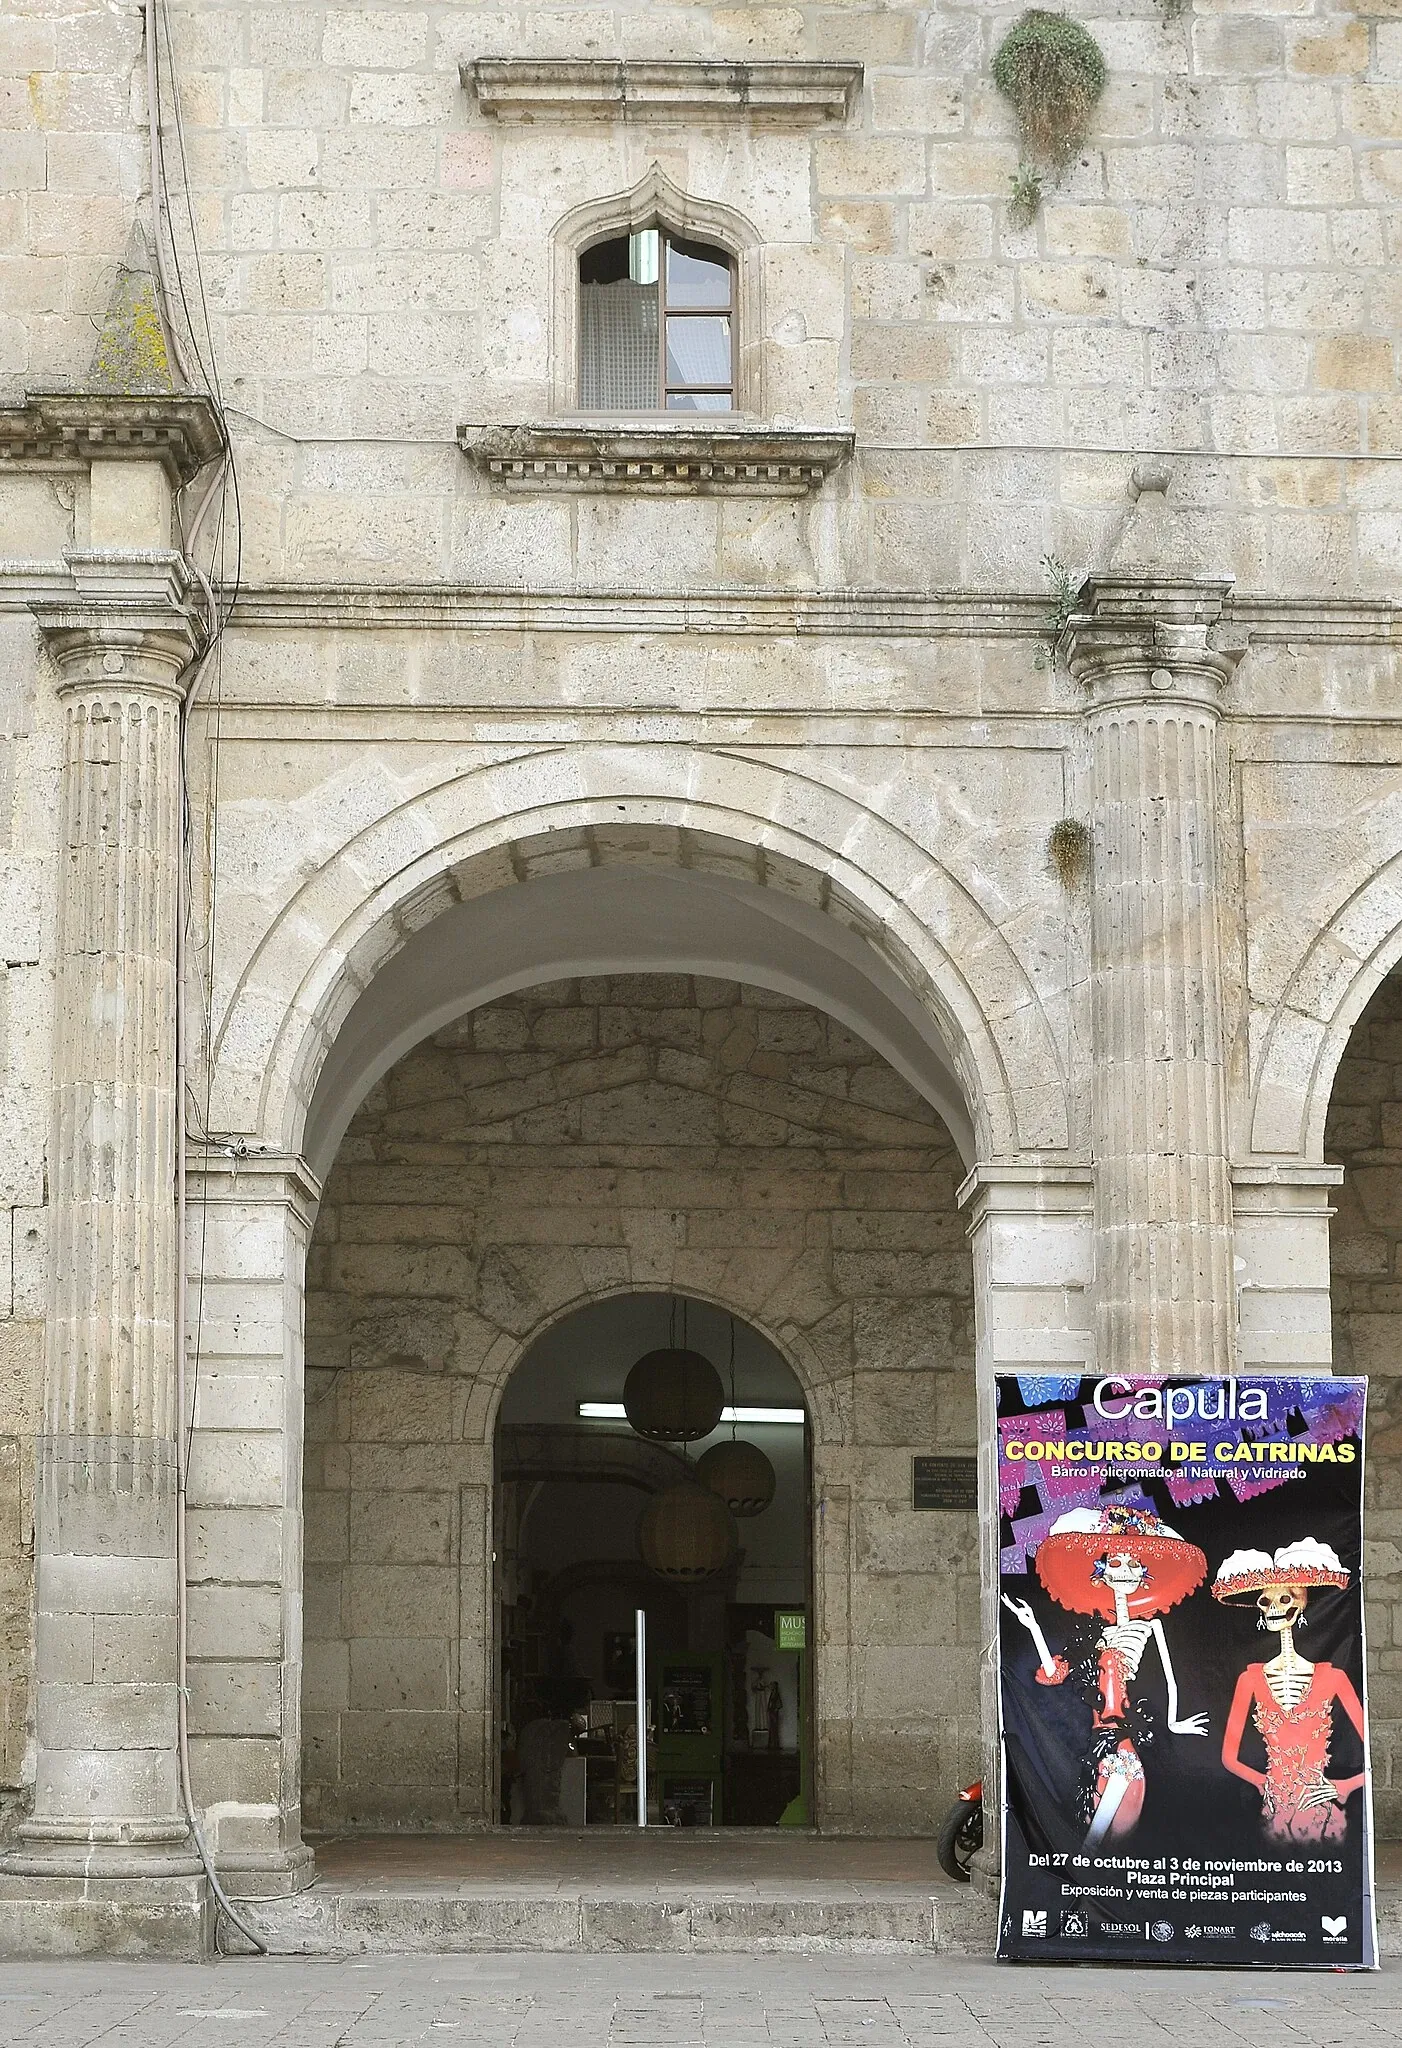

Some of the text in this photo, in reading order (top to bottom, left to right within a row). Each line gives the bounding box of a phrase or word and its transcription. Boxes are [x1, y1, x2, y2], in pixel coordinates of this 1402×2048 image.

[1093, 1377, 1268, 1430] Capula
[1005, 1441, 1356, 1463] CONCURSO DE CATRINAS
[1051, 1466, 1307, 1480] Barro Policromado al Natural y Vidriado
[1028, 1853, 1343, 1873] Del 27 de octubre al 3 de noviembre de 2013
[1127, 1871, 1235, 1888] Plaza Principal
[1061, 1884, 1307, 1904] Exposición y venta de piezas participantes
[1100, 1922, 1141, 1932] SEDESOL
